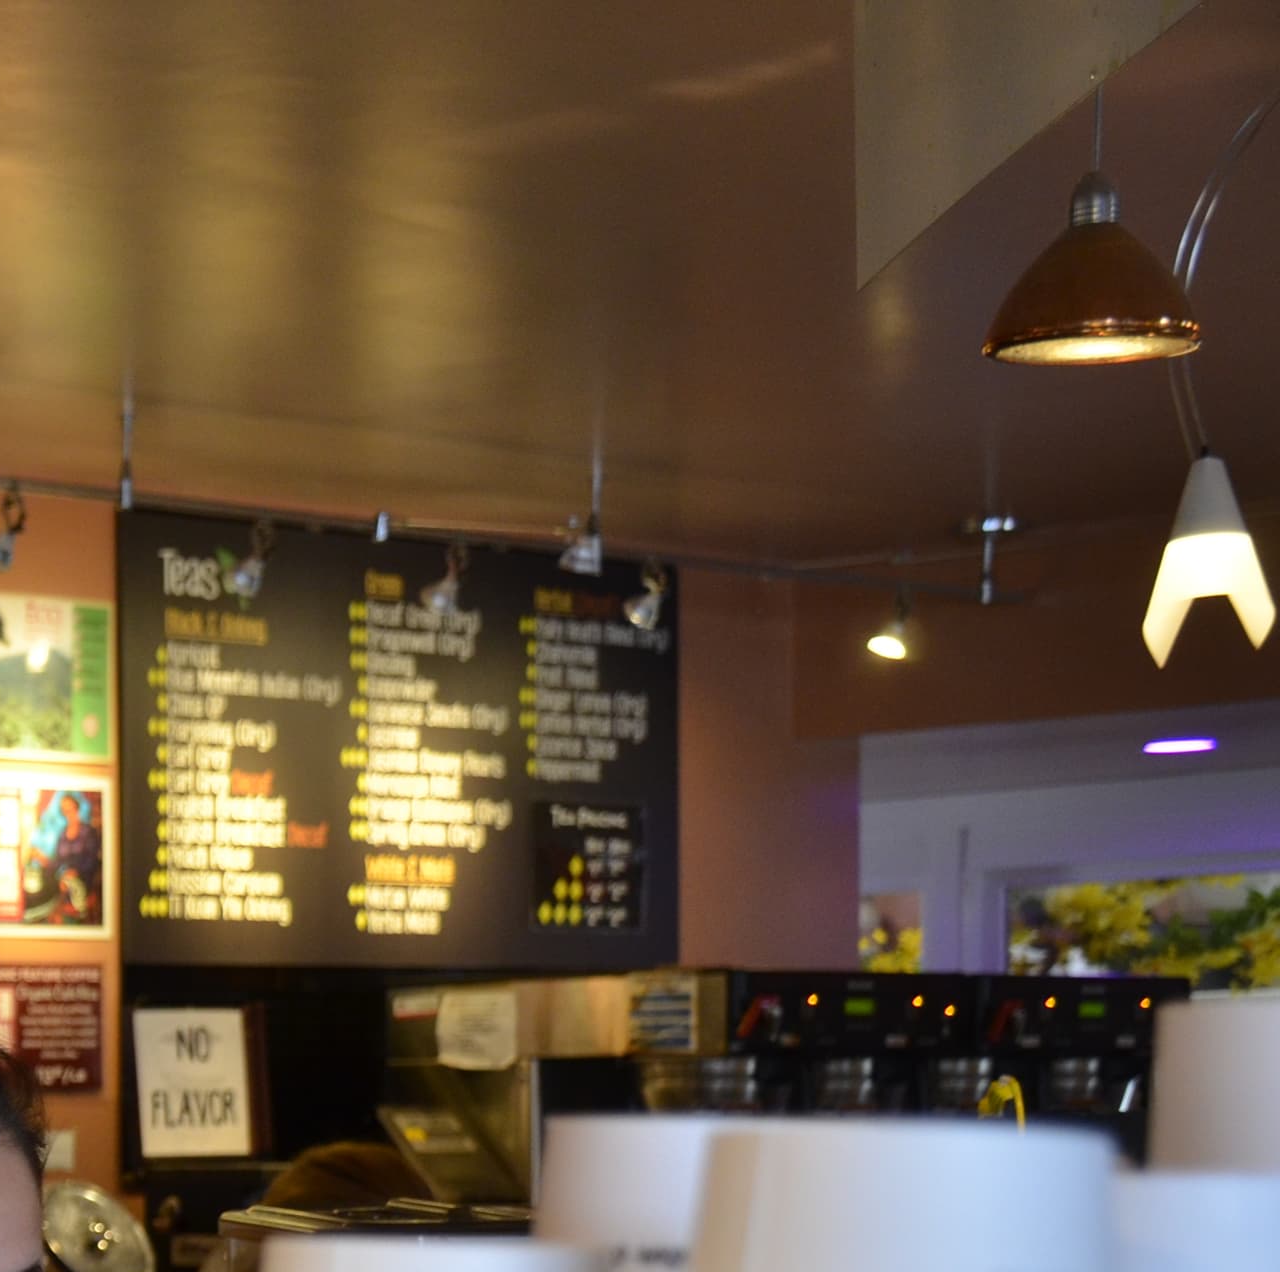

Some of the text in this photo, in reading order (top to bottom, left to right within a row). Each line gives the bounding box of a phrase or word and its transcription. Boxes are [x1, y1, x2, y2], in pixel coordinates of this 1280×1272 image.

[158, 548, 221, 600] Teas
[175, 1024, 210, 1063] NO
[151, 1087, 236, 1130] FLAVOR
